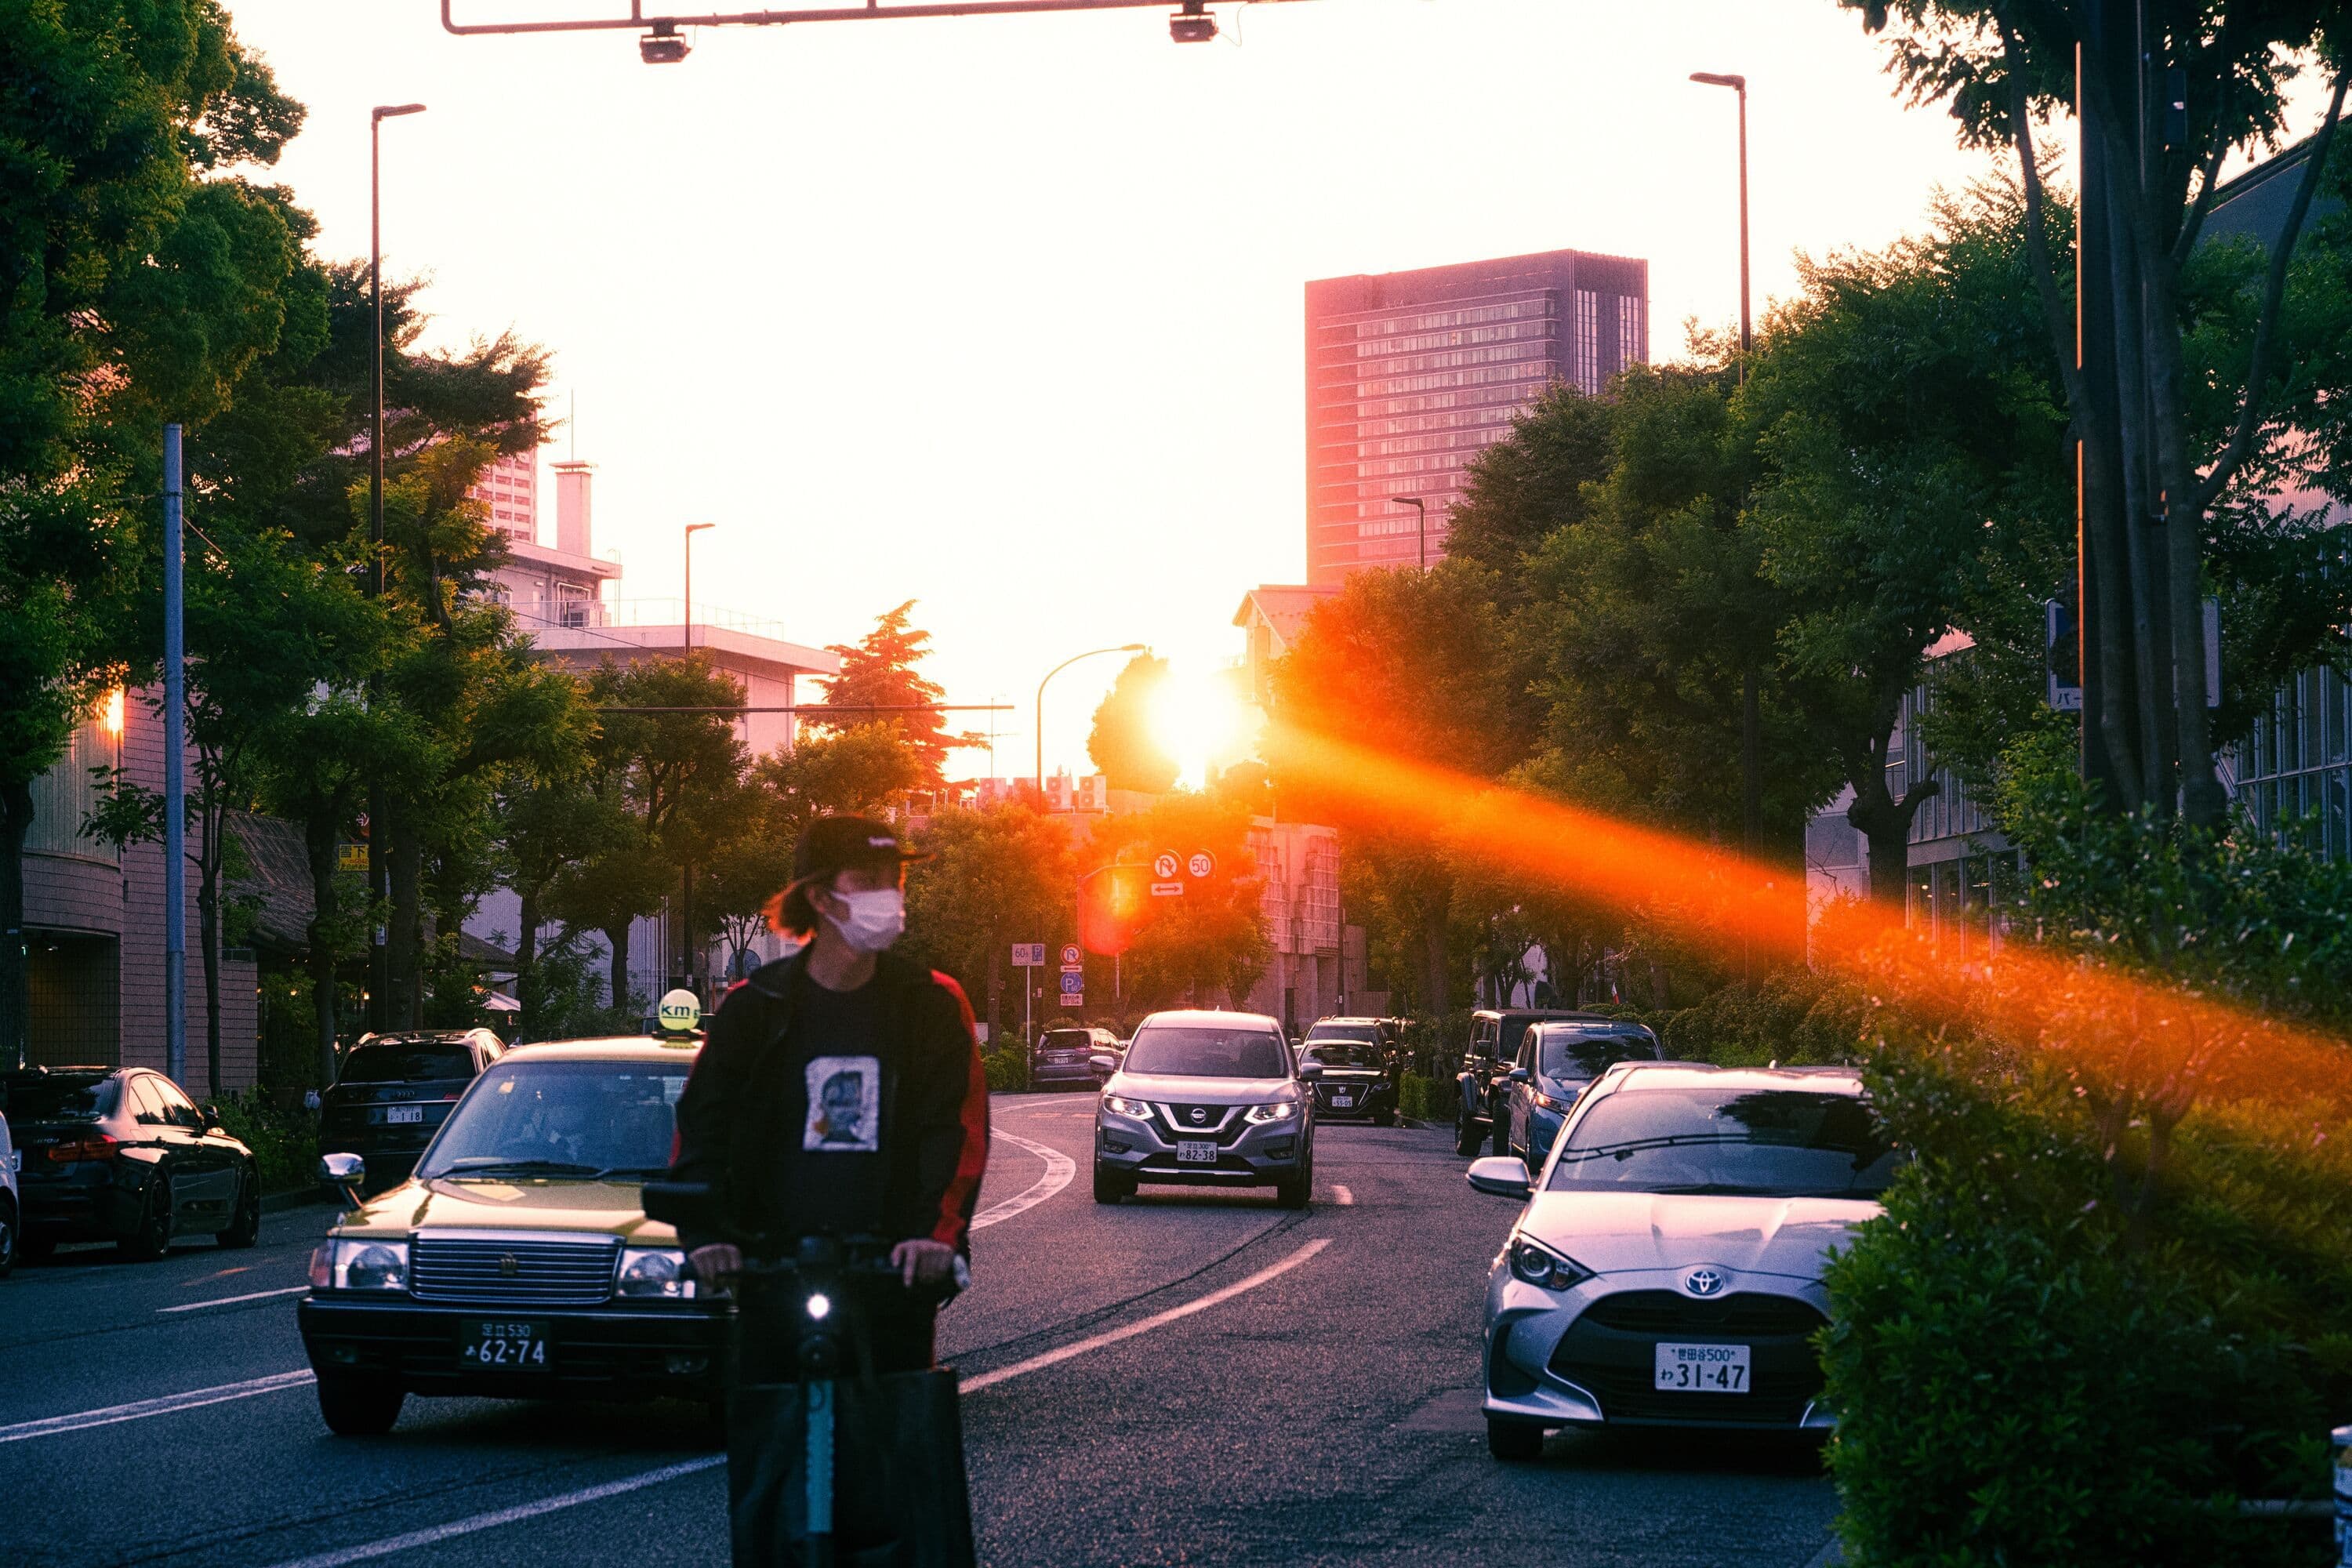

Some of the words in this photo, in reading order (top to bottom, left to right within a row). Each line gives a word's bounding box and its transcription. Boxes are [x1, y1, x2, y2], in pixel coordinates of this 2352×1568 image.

[1192, 859, 1209, 873] 50
[1065, 978, 1074, 992] P
[662, 1004, 690, 1016] km
[1185, 1149, 1214, 1160] 82-38
[479, 1339, 545, 1363] 62-74
[1676, 1363, 1745, 1388] 31-47
